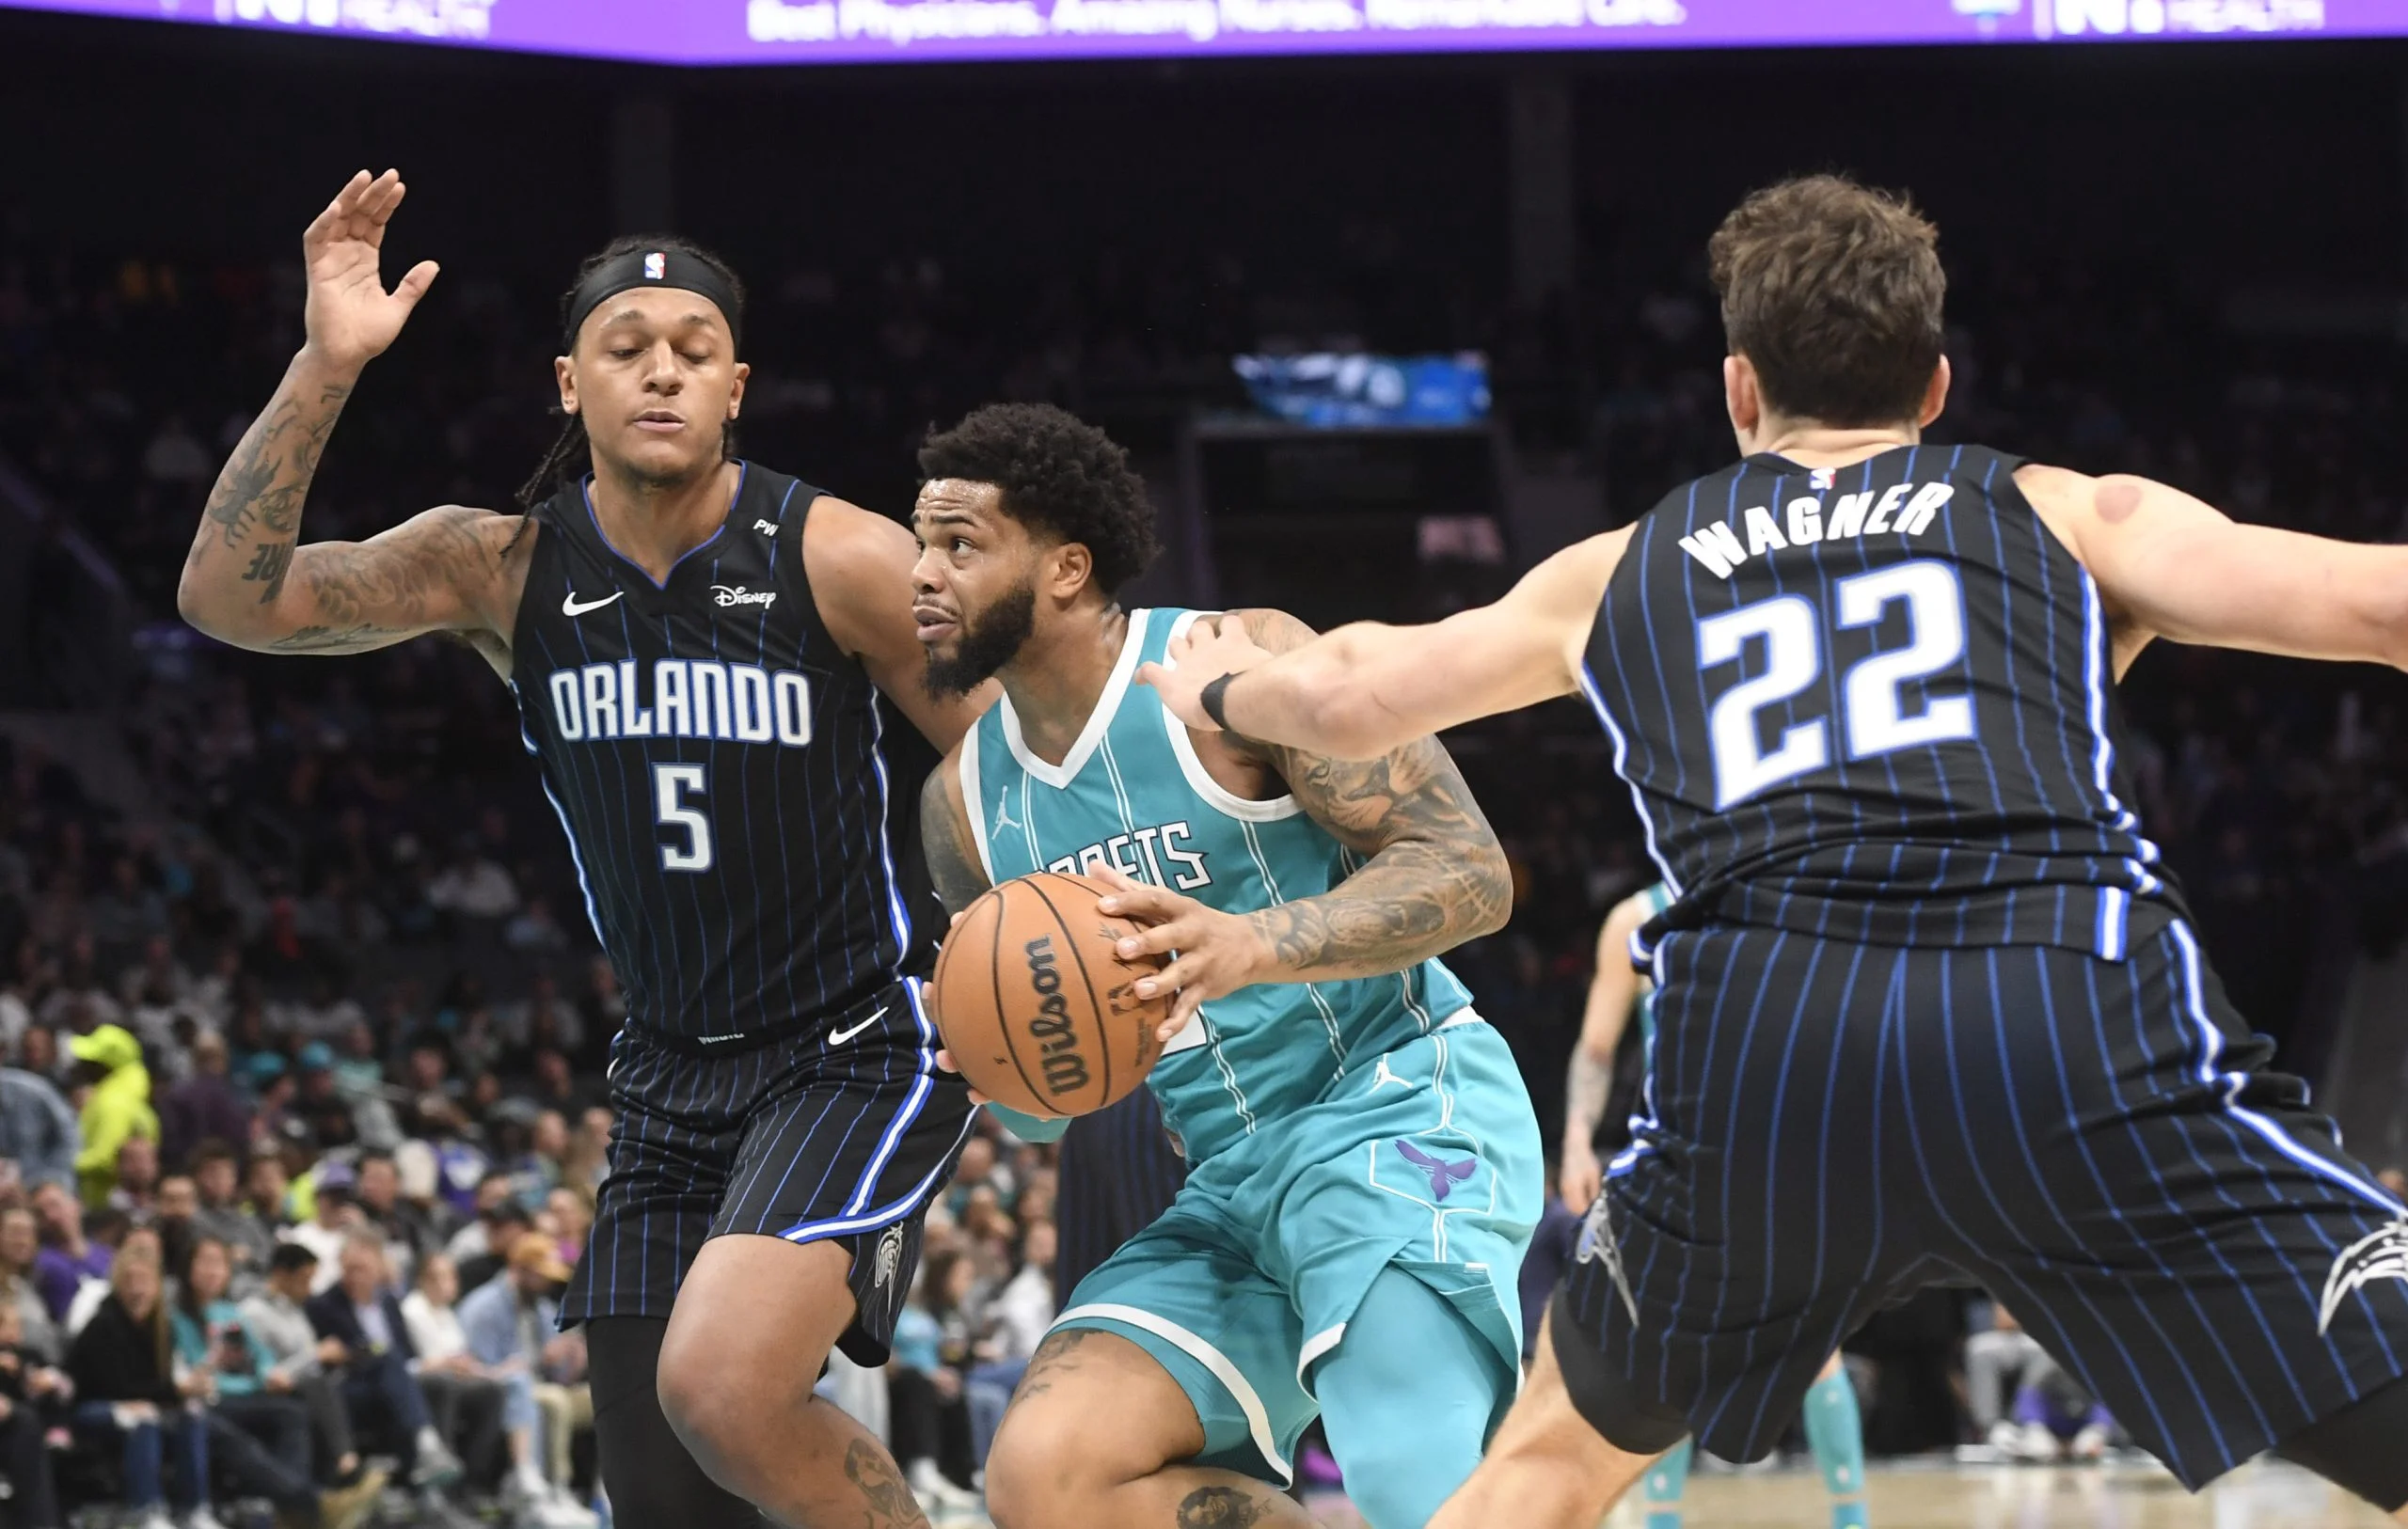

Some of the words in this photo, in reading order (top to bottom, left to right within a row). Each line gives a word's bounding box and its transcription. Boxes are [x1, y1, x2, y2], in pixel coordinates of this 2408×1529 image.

[752, 519, 779, 536] PW
[1678, 481, 1956, 579] WAGNER
[549, 659, 813, 746] ORLANDO
[1696, 558, 1977, 812] 22
[652, 763, 714, 873] 5
[1024, 934, 1090, 1096] Wilson
